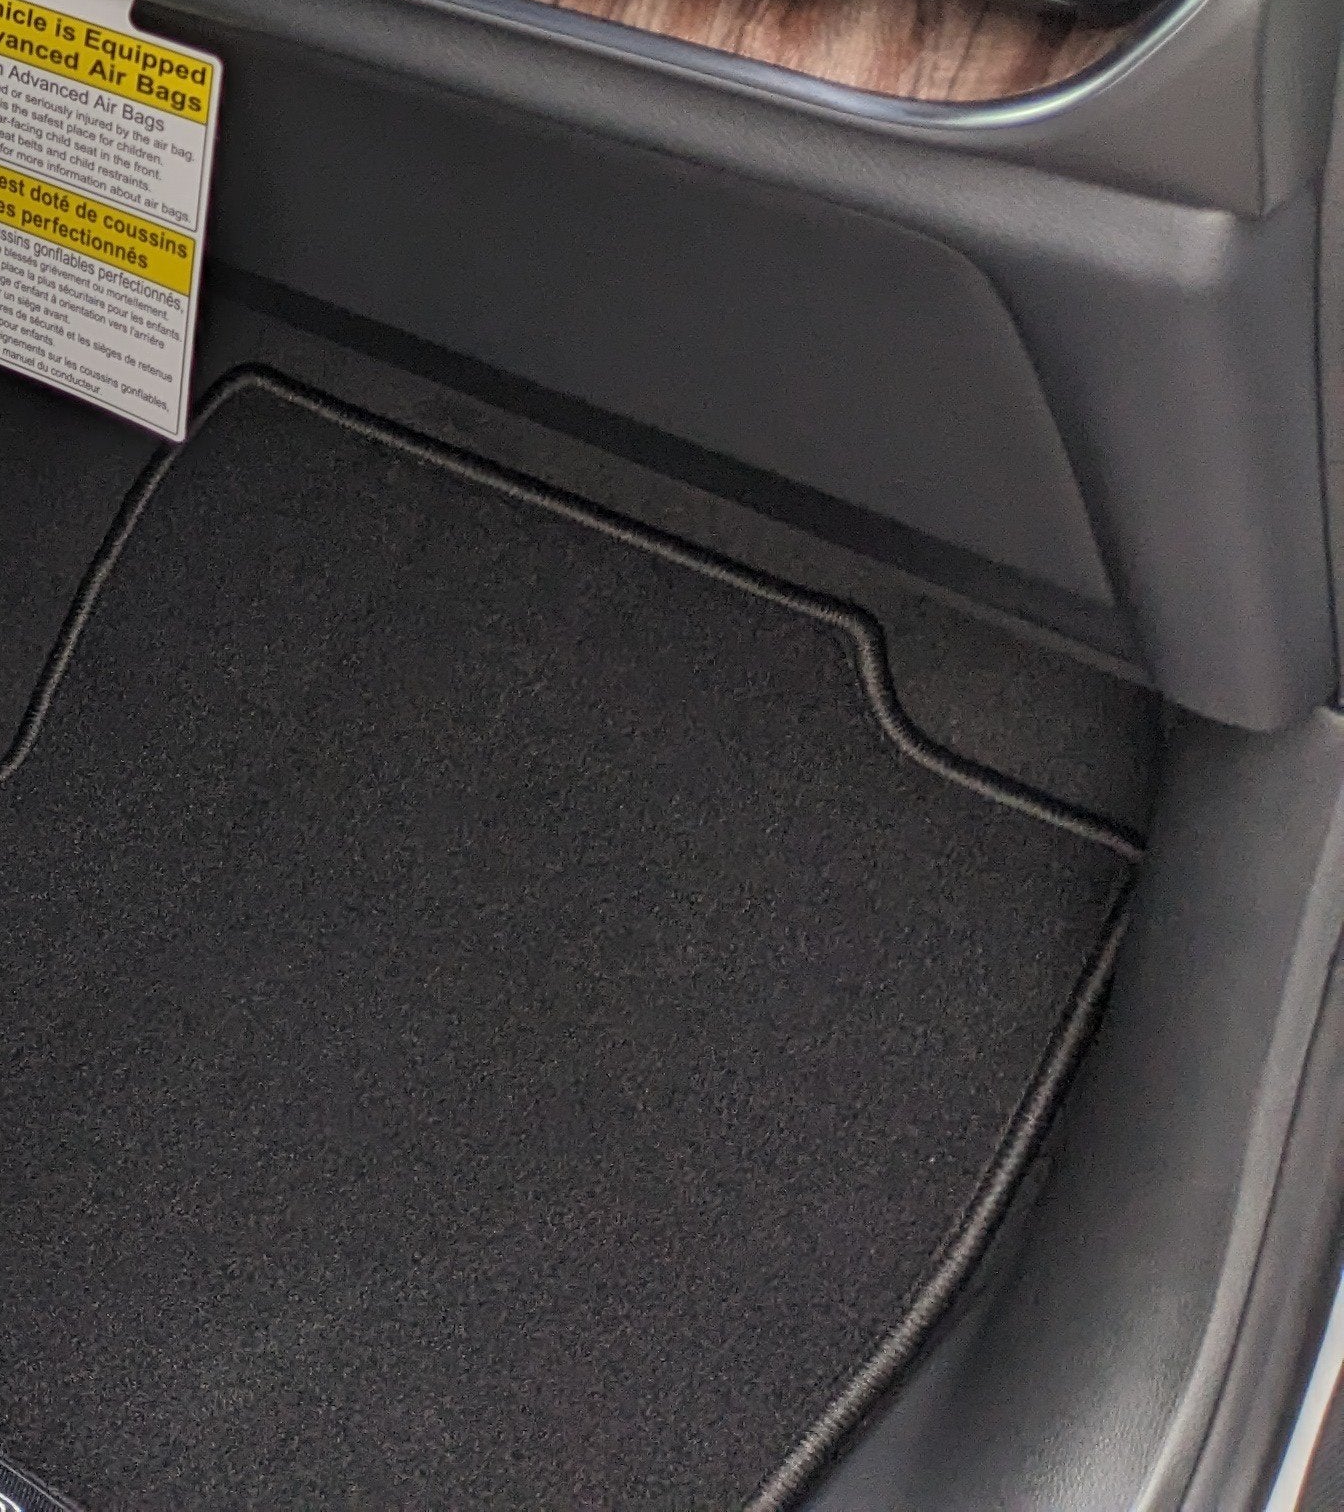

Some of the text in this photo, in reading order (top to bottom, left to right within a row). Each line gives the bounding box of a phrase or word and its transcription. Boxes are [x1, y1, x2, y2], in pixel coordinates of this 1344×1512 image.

[55, 18, 76, 41] is
[84, 28, 207, 86] Equipped
[8, 65, 89, 105] Advanced
[93, 94, 118, 114] Air
[122, 103, 164, 132] Bags
[88, 59, 127, 86] Air
[136, 73, 202, 112] Bags
[0, 97, 9, 111] is
[11, 103, 29, 117] the
[31, 111, 64, 130] safest
[66, 124, 97, 141] place
[99, 133, 115, 147] for
[116, 141, 163, 166] children.
[11, 89, 23, 99] or
[25, 94, 73, 120] seriously
[75, 109, 113, 132] injured
[115, 124, 130, 139] by
[132, 130, 150, 145] the
[153, 139, 169, 151] air
[171, 143, 194, 163] bag.
[45, 131, 71, 148] child
[74, 142, 97, 157] seat
[100, 149, 110, 162] in
[113, 154, 131, 169] the
[133, 161, 161, 181] front.
[0, 142, 14, 157] for
[16, 151, 44, 168] more
[46, 160, 107, 191] information
[110, 185, 142, 204] about
[144, 198, 159, 210] air
[161, 202, 191, 224] bags.
[17, 134, 44, 153] belts
[46, 147, 67, 161] and
[69, 155, 95, 171] child
[97, 165, 151, 192] restraints.
[21, 209, 148, 269] perfectionnés
[30, 185, 70, 213] doté
[75, 202, 97, 223] de
[103, 215, 187, 259] coussins
[0, 261, 25, 277] place
[27, 270, 35, 281] la
[37, 275, 56, 289] plus
[107, 304, 129, 318] pour
[130, 311, 144, 326] les
[33, 242, 95, 275] gonflables
[98, 267, 185, 314] perfectionnés,
[92, 283, 105, 294] ou
[15, 310, 27, 322] de
[66, 331, 76, 341] et
[77, 334, 91, 347] les
[124, 354, 136, 367] de
[138, 361, 173, 383] retenue
[59, 299, 106, 324] orientation
[108, 319, 128, 334] vers
[2, 348, 35, 367] manuel
[37, 361, 49, 373] du
[47, 352, 63, 364] sur
[64, 358, 77, 374] les
[79, 365, 119, 388] coussins
